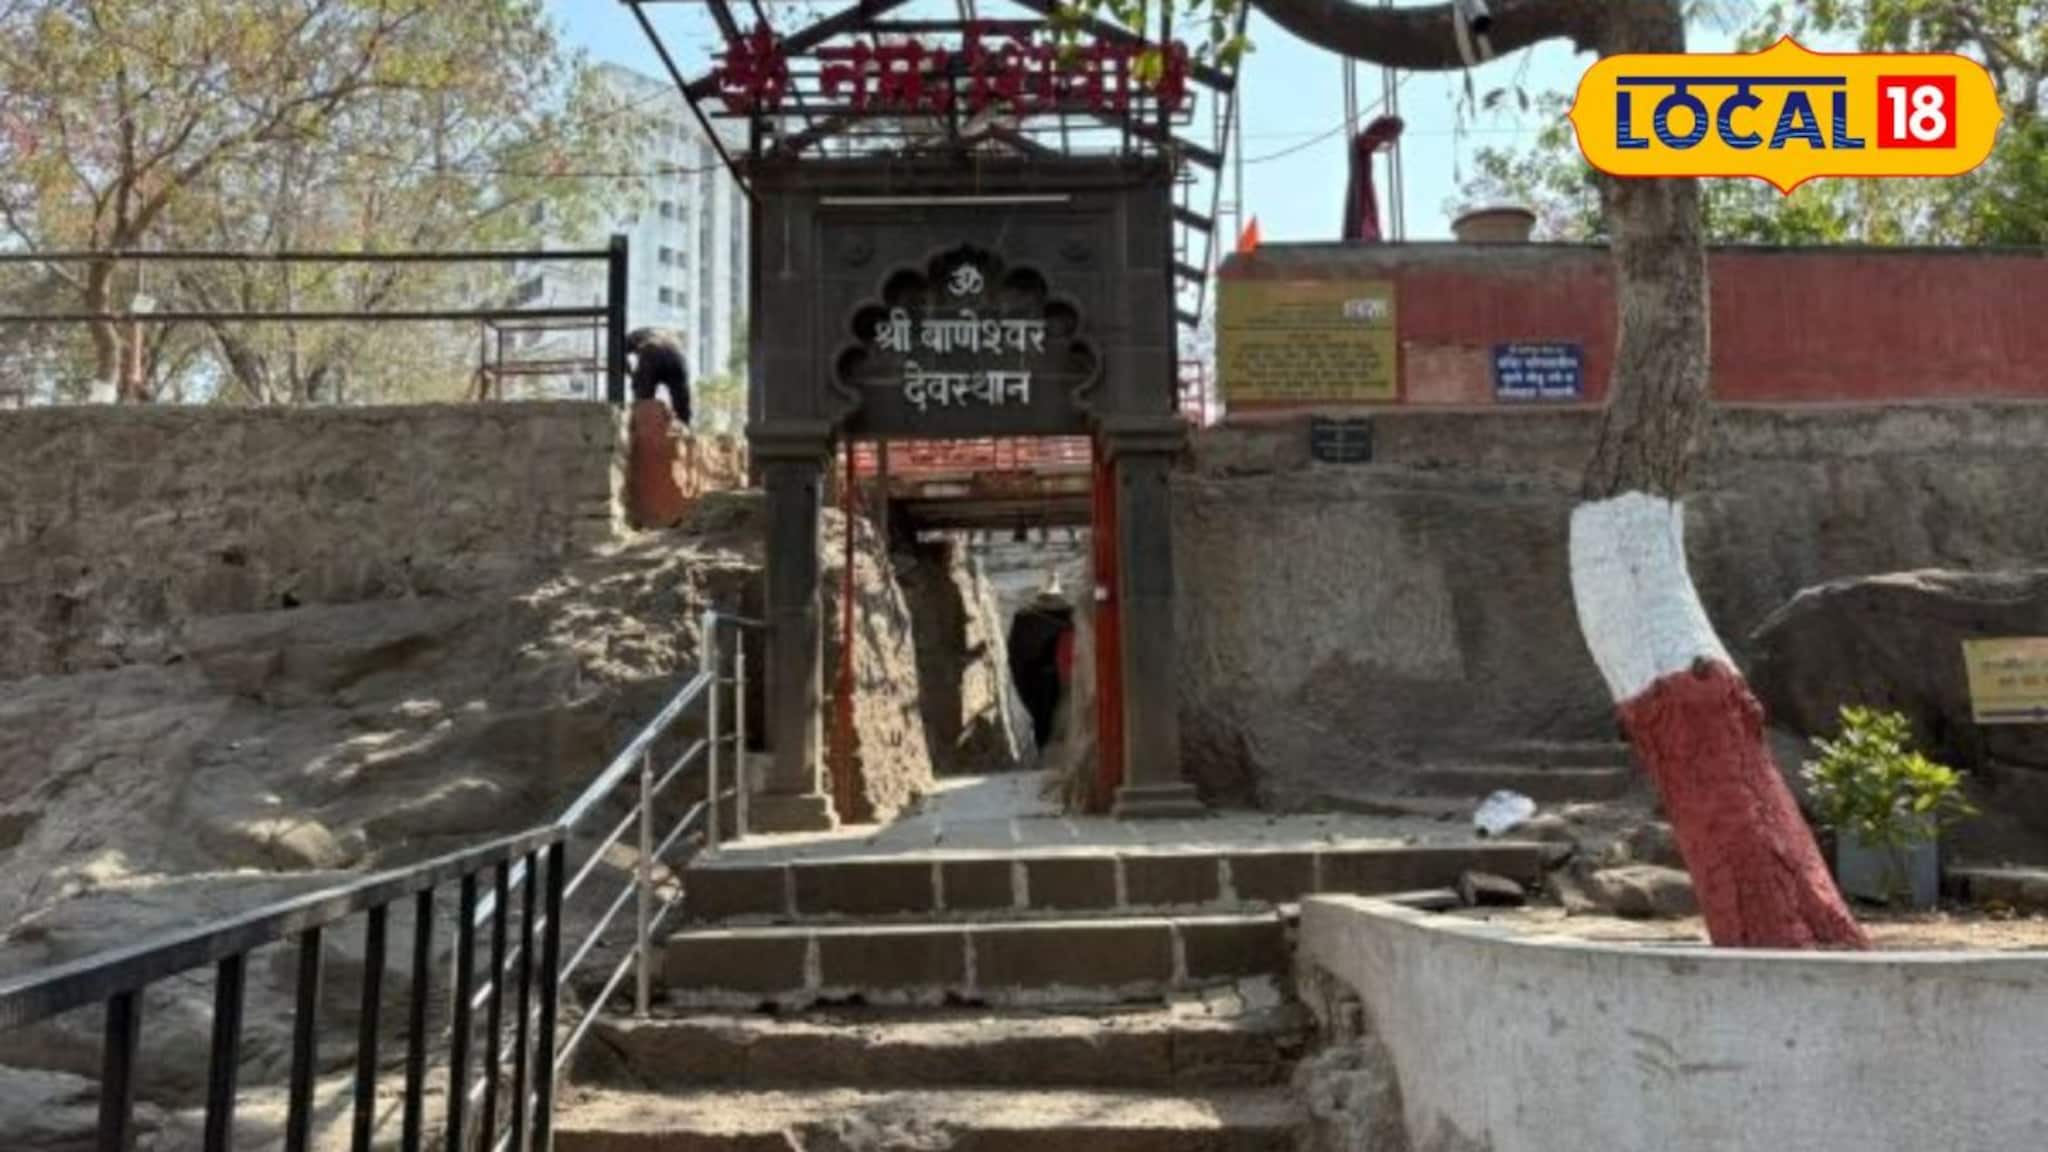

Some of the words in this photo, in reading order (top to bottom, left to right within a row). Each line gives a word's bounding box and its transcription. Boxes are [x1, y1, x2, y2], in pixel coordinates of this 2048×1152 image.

[947, 263, 984, 296] ॐ
[874, 307, 912, 353] श्री
[921, 308, 1047, 355] बाणेश्वर
[903, 360, 1033, 411] देवस्थान
